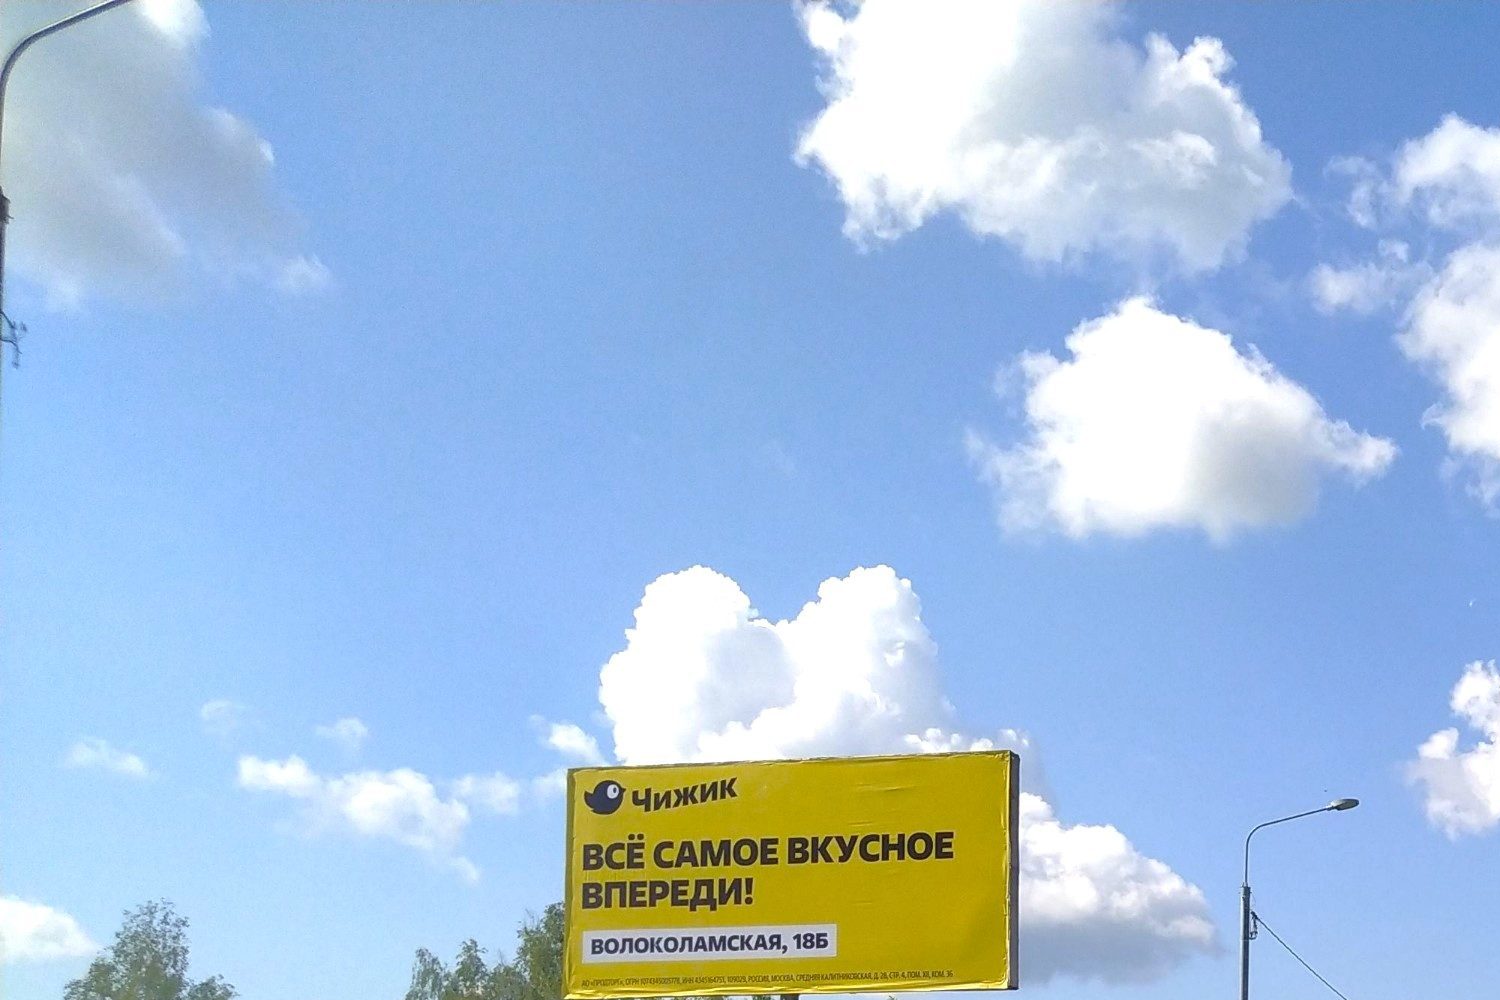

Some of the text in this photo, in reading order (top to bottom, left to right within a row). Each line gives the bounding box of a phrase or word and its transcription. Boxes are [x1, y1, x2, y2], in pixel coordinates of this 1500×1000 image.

[582, 831, 955, 872] ВСЁ САМОЕ ВКУСНОЕ
[581, 877, 754, 913] ВПЕРЕДИ!
[590, 932, 829, 957] ВОЛОКОЛАМСКАЯ, 18Б
